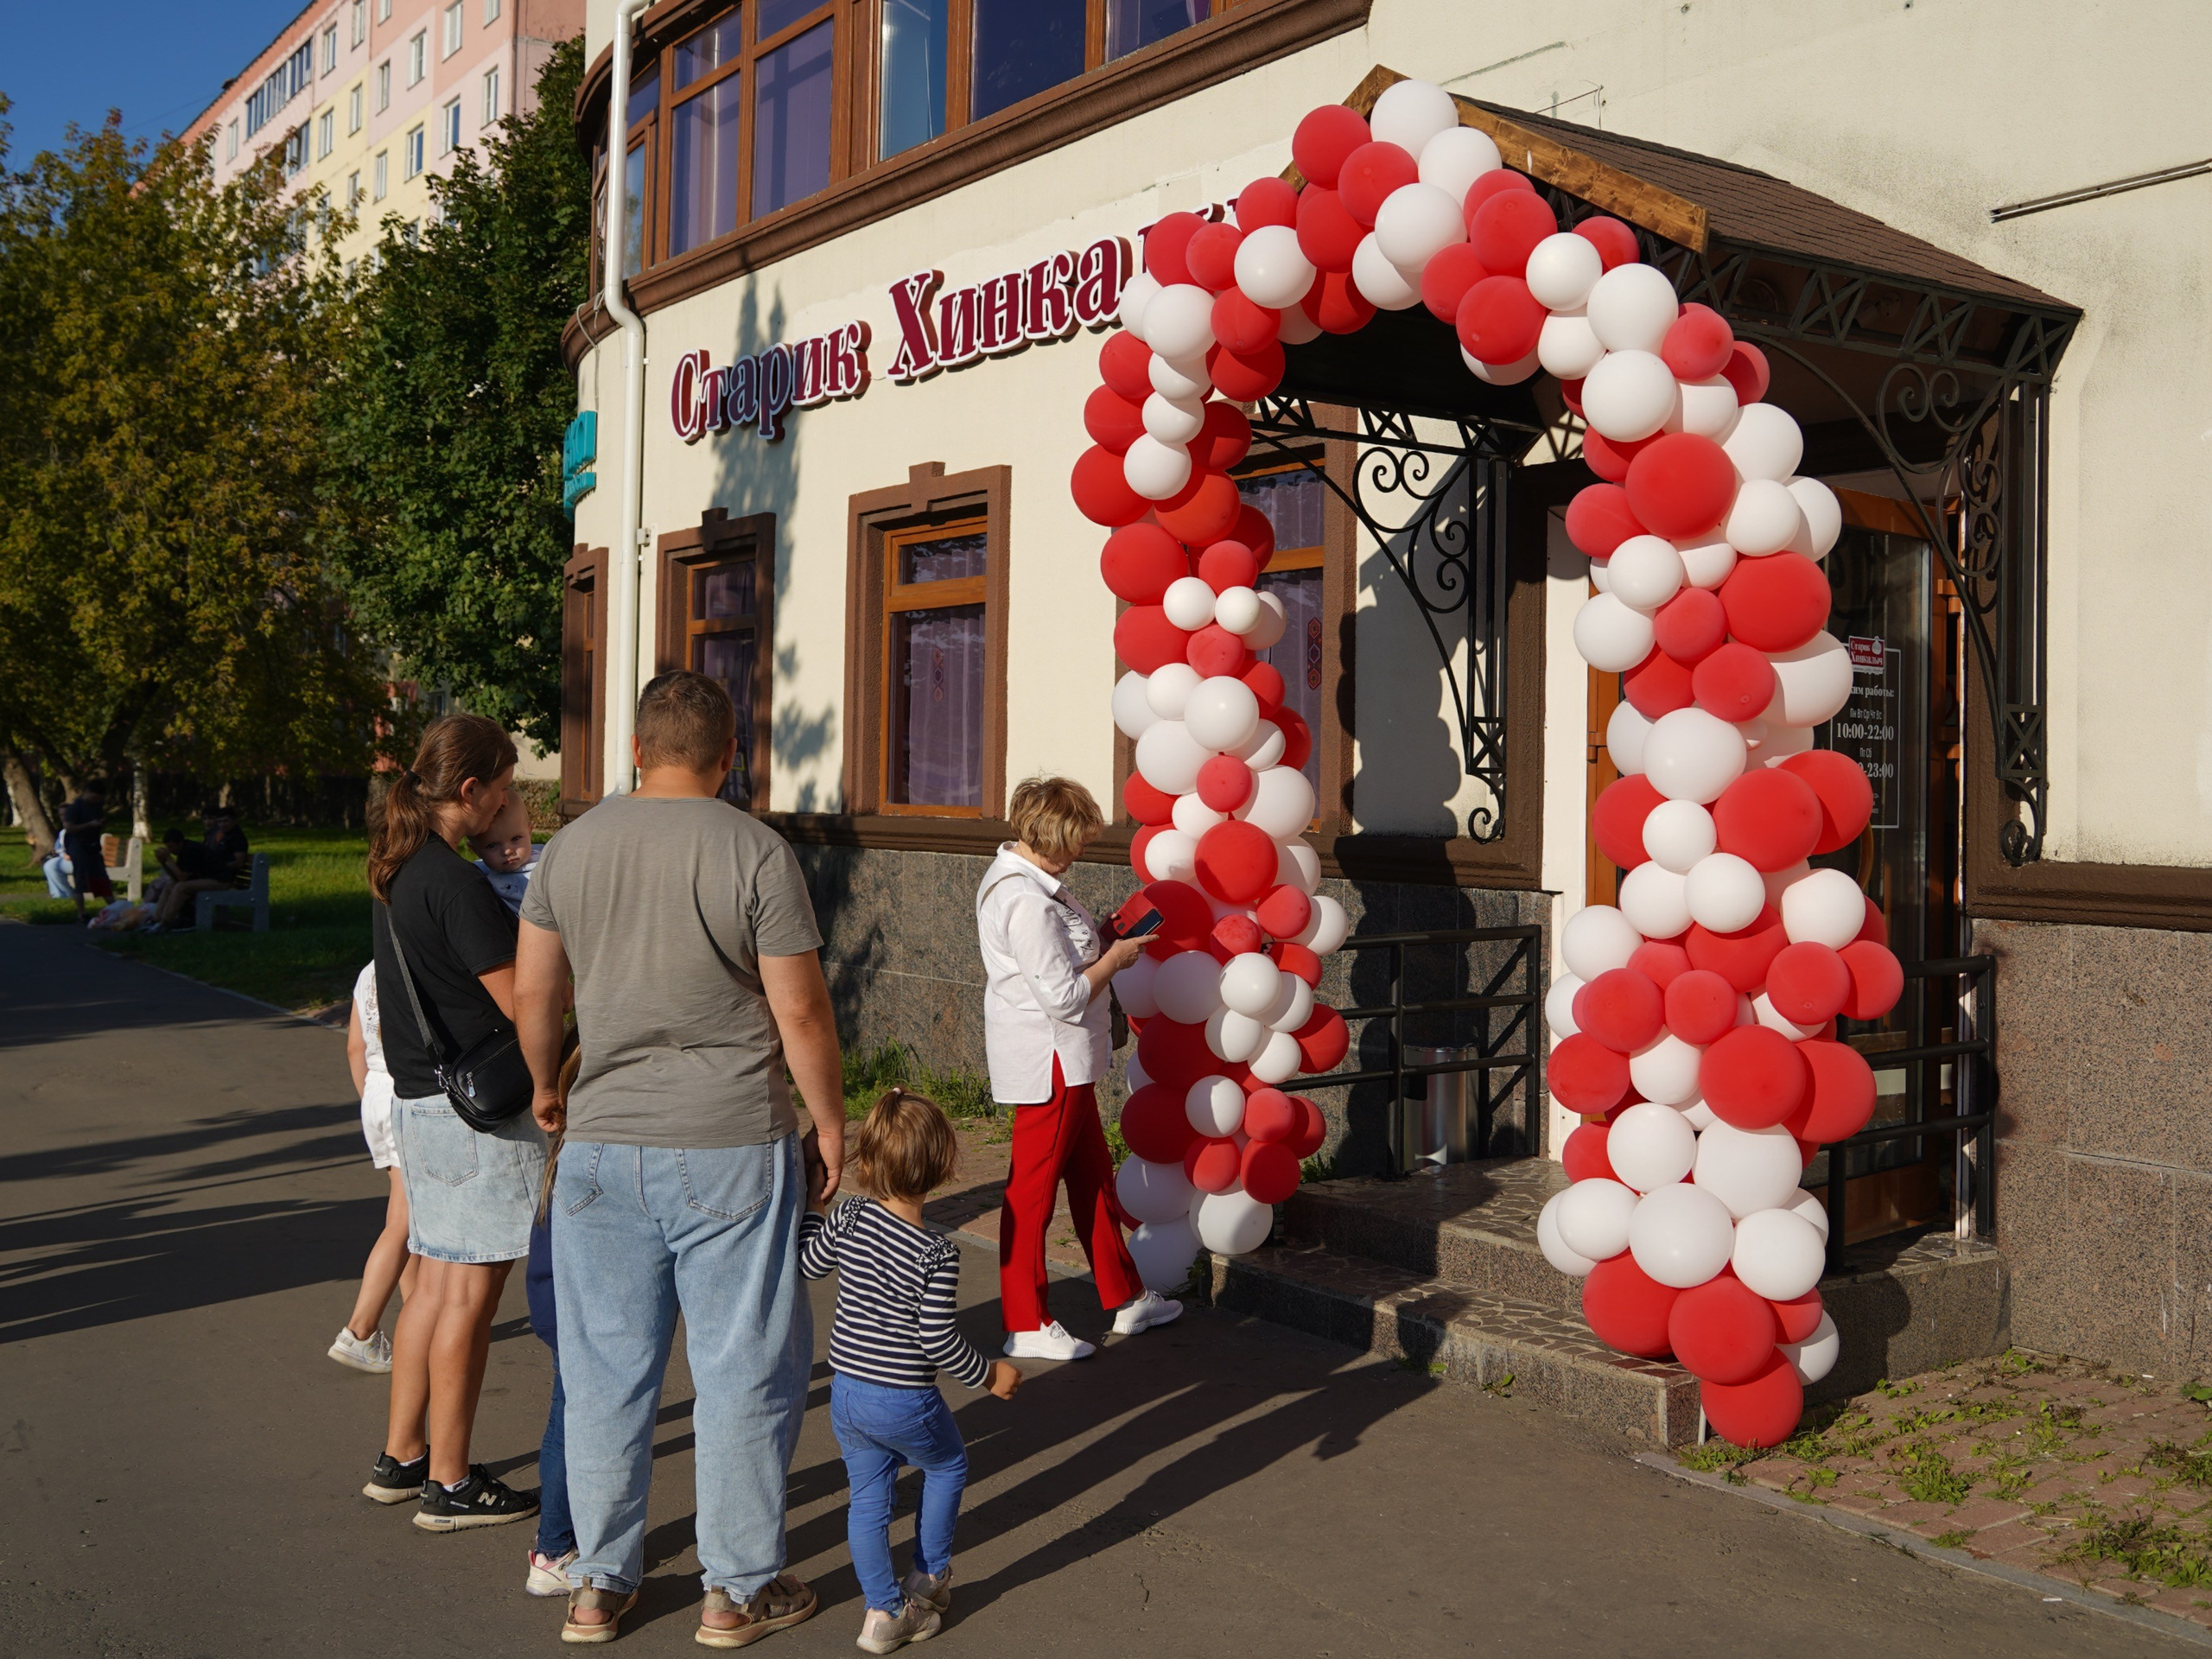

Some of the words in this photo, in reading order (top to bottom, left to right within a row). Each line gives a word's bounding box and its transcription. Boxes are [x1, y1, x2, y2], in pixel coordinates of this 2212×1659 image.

[671, 320, 871, 441] Старик
[886, 201, 1239, 380] Хинка
[1865, 684, 1894, 698] работы:
[1837, 722, 1894, 741] 10:00-22:00
[478, 1492, 497, 1506] N
